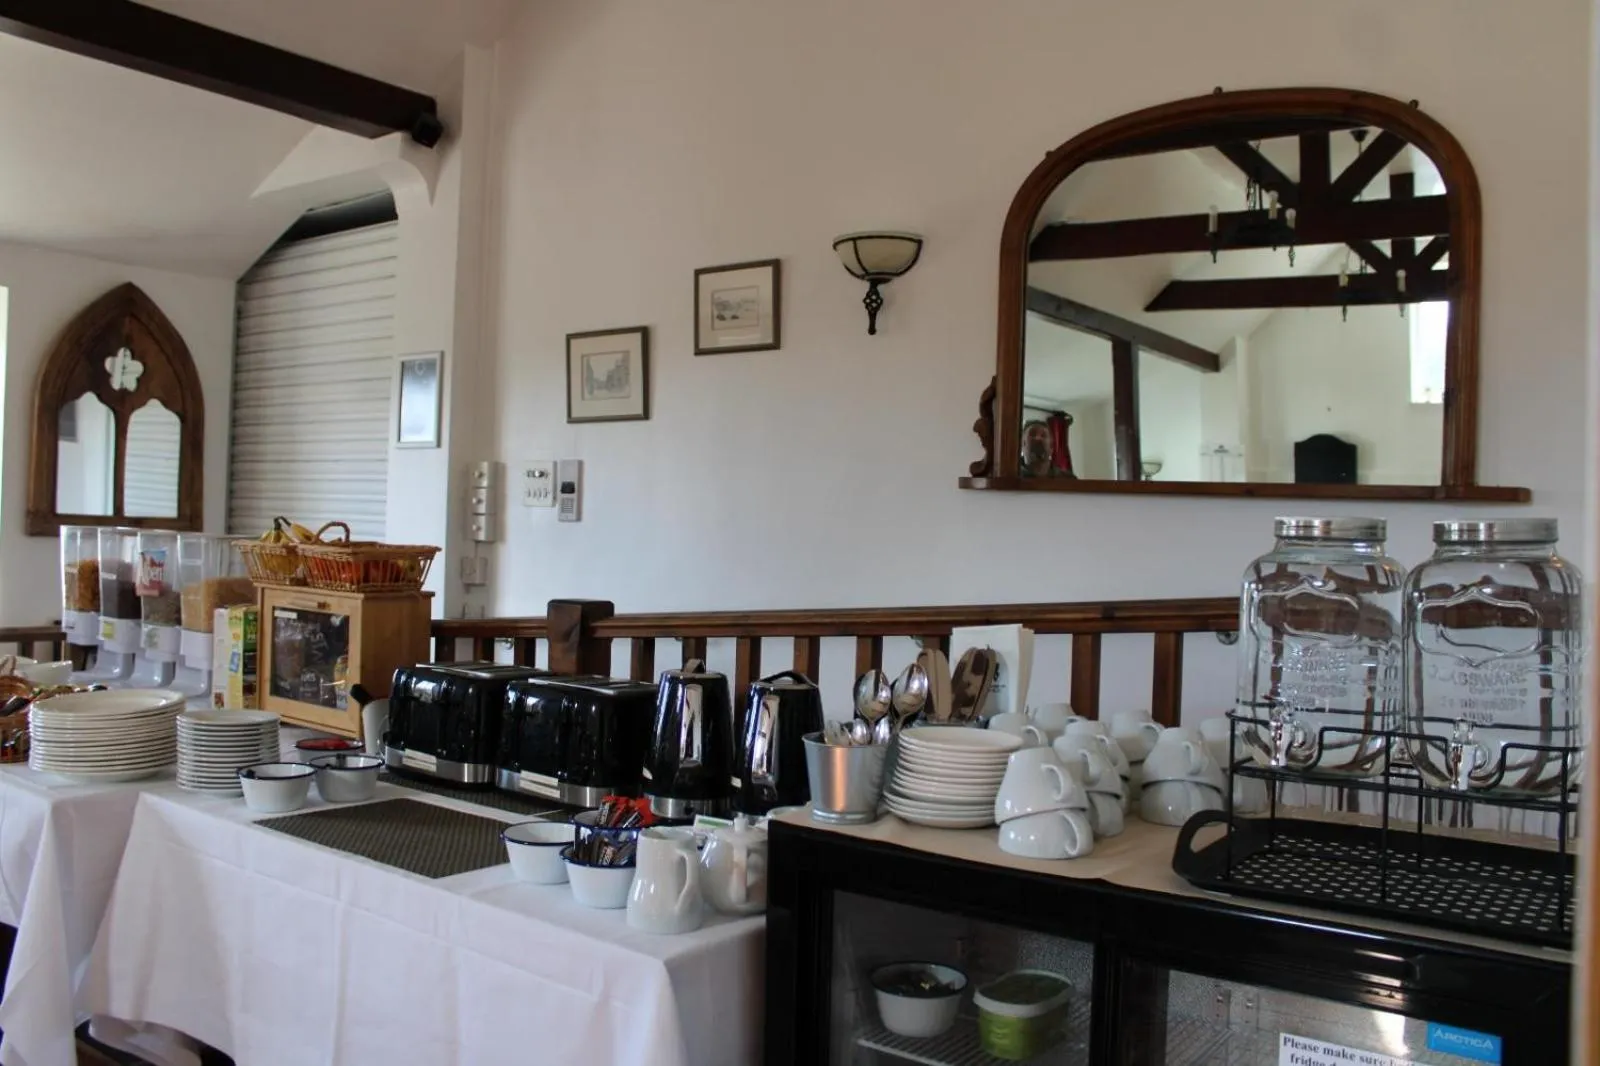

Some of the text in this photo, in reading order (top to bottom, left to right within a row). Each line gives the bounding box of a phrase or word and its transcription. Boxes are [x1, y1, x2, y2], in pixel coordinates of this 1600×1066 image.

[1283, 1035, 1320, 1054] Please
[1323, 1046, 1357, 1061] make
[1359, 1055, 1386, 1066] sure
